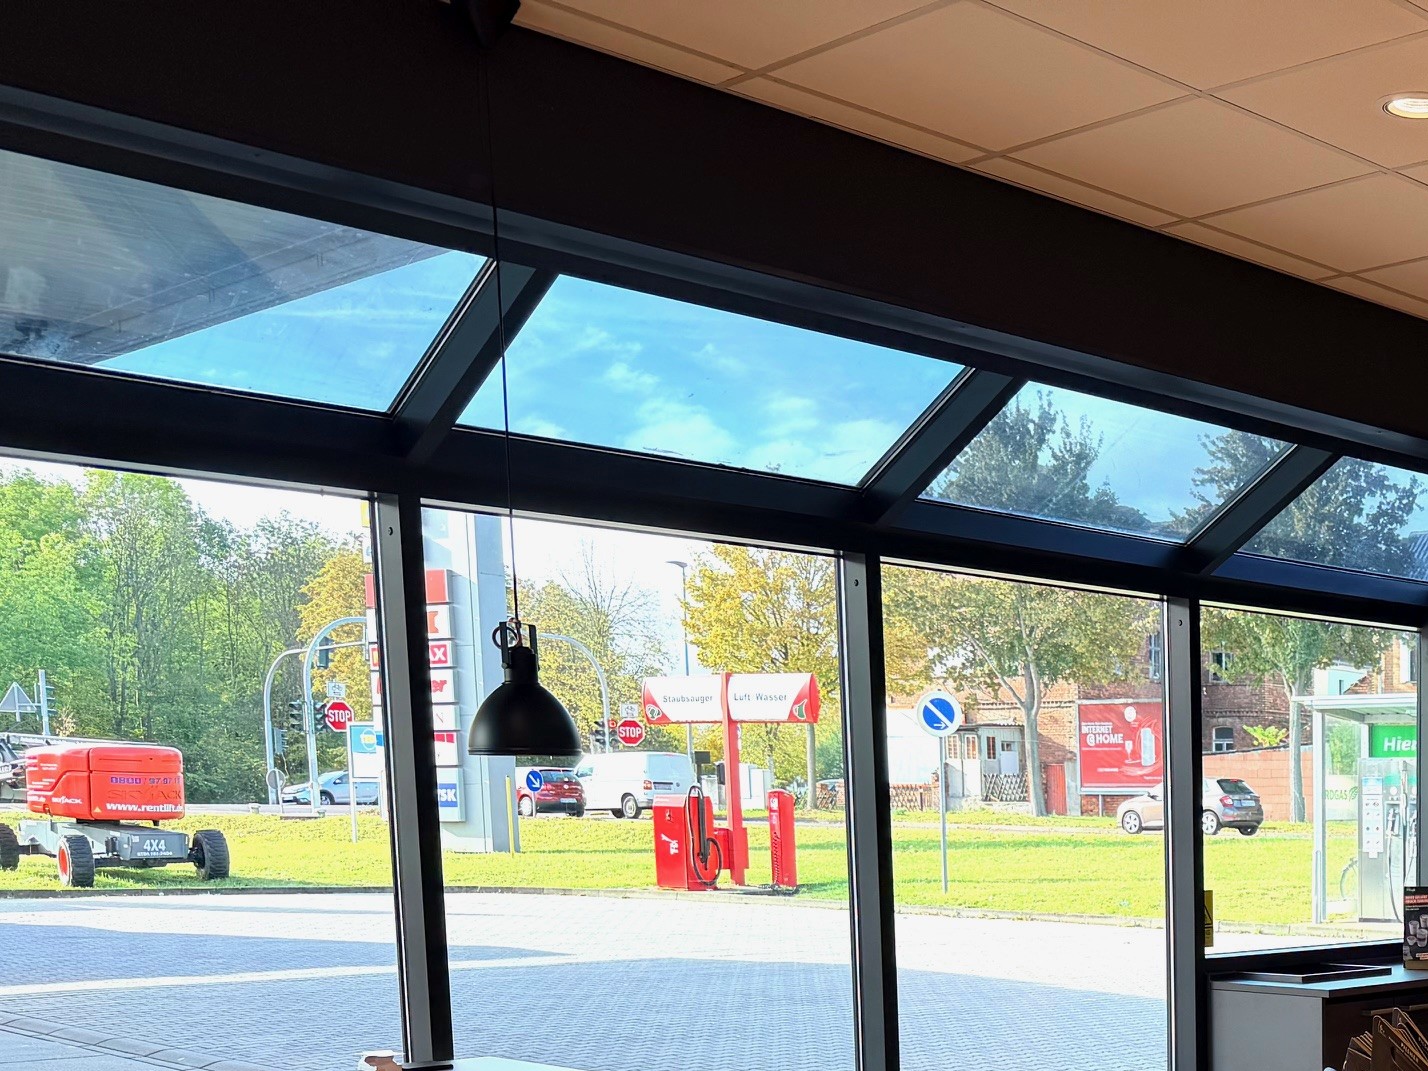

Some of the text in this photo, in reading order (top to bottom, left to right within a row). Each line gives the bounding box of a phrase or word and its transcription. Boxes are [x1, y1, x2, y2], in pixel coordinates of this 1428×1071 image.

[662, 695, 713, 704] Staubsauger
[733, 693, 788, 701] Luft Wasser
[328, 709, 351, 722] STOP
[619, 727, 642, 738] STOP
[1086, 733, 1124, 747] @HOME
[143, 839, 166, 851] 4X4
